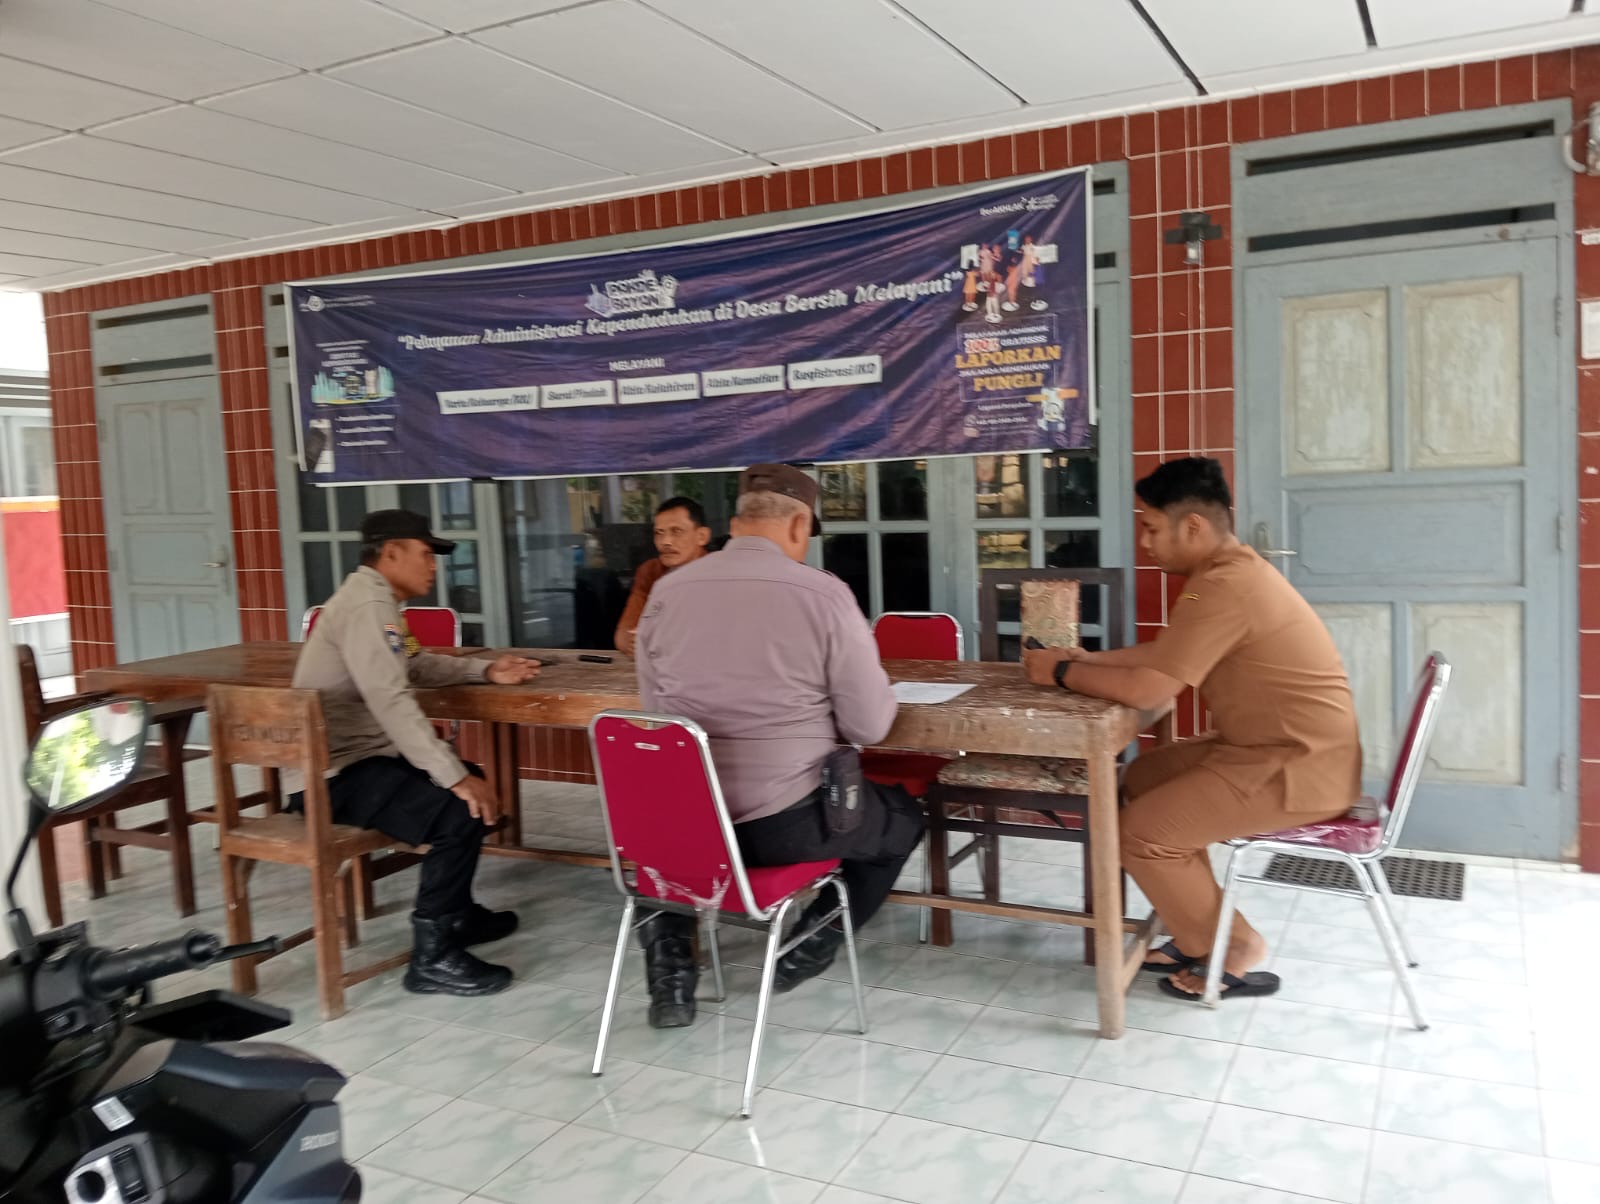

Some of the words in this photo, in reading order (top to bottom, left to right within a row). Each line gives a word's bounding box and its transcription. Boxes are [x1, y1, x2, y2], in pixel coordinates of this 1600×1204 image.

[481, 320, 584, 344] Administrasi
[586, 308, 714, 336] Kependudukan
[714, 302, 734, 320] di
[735, 300, 782, 319] Desa
[784, 289, 849, 313] Bersih
[955, 345, 1062, 369] LAPORKAN
[973, 372, 1045, 392] PUNGLI
